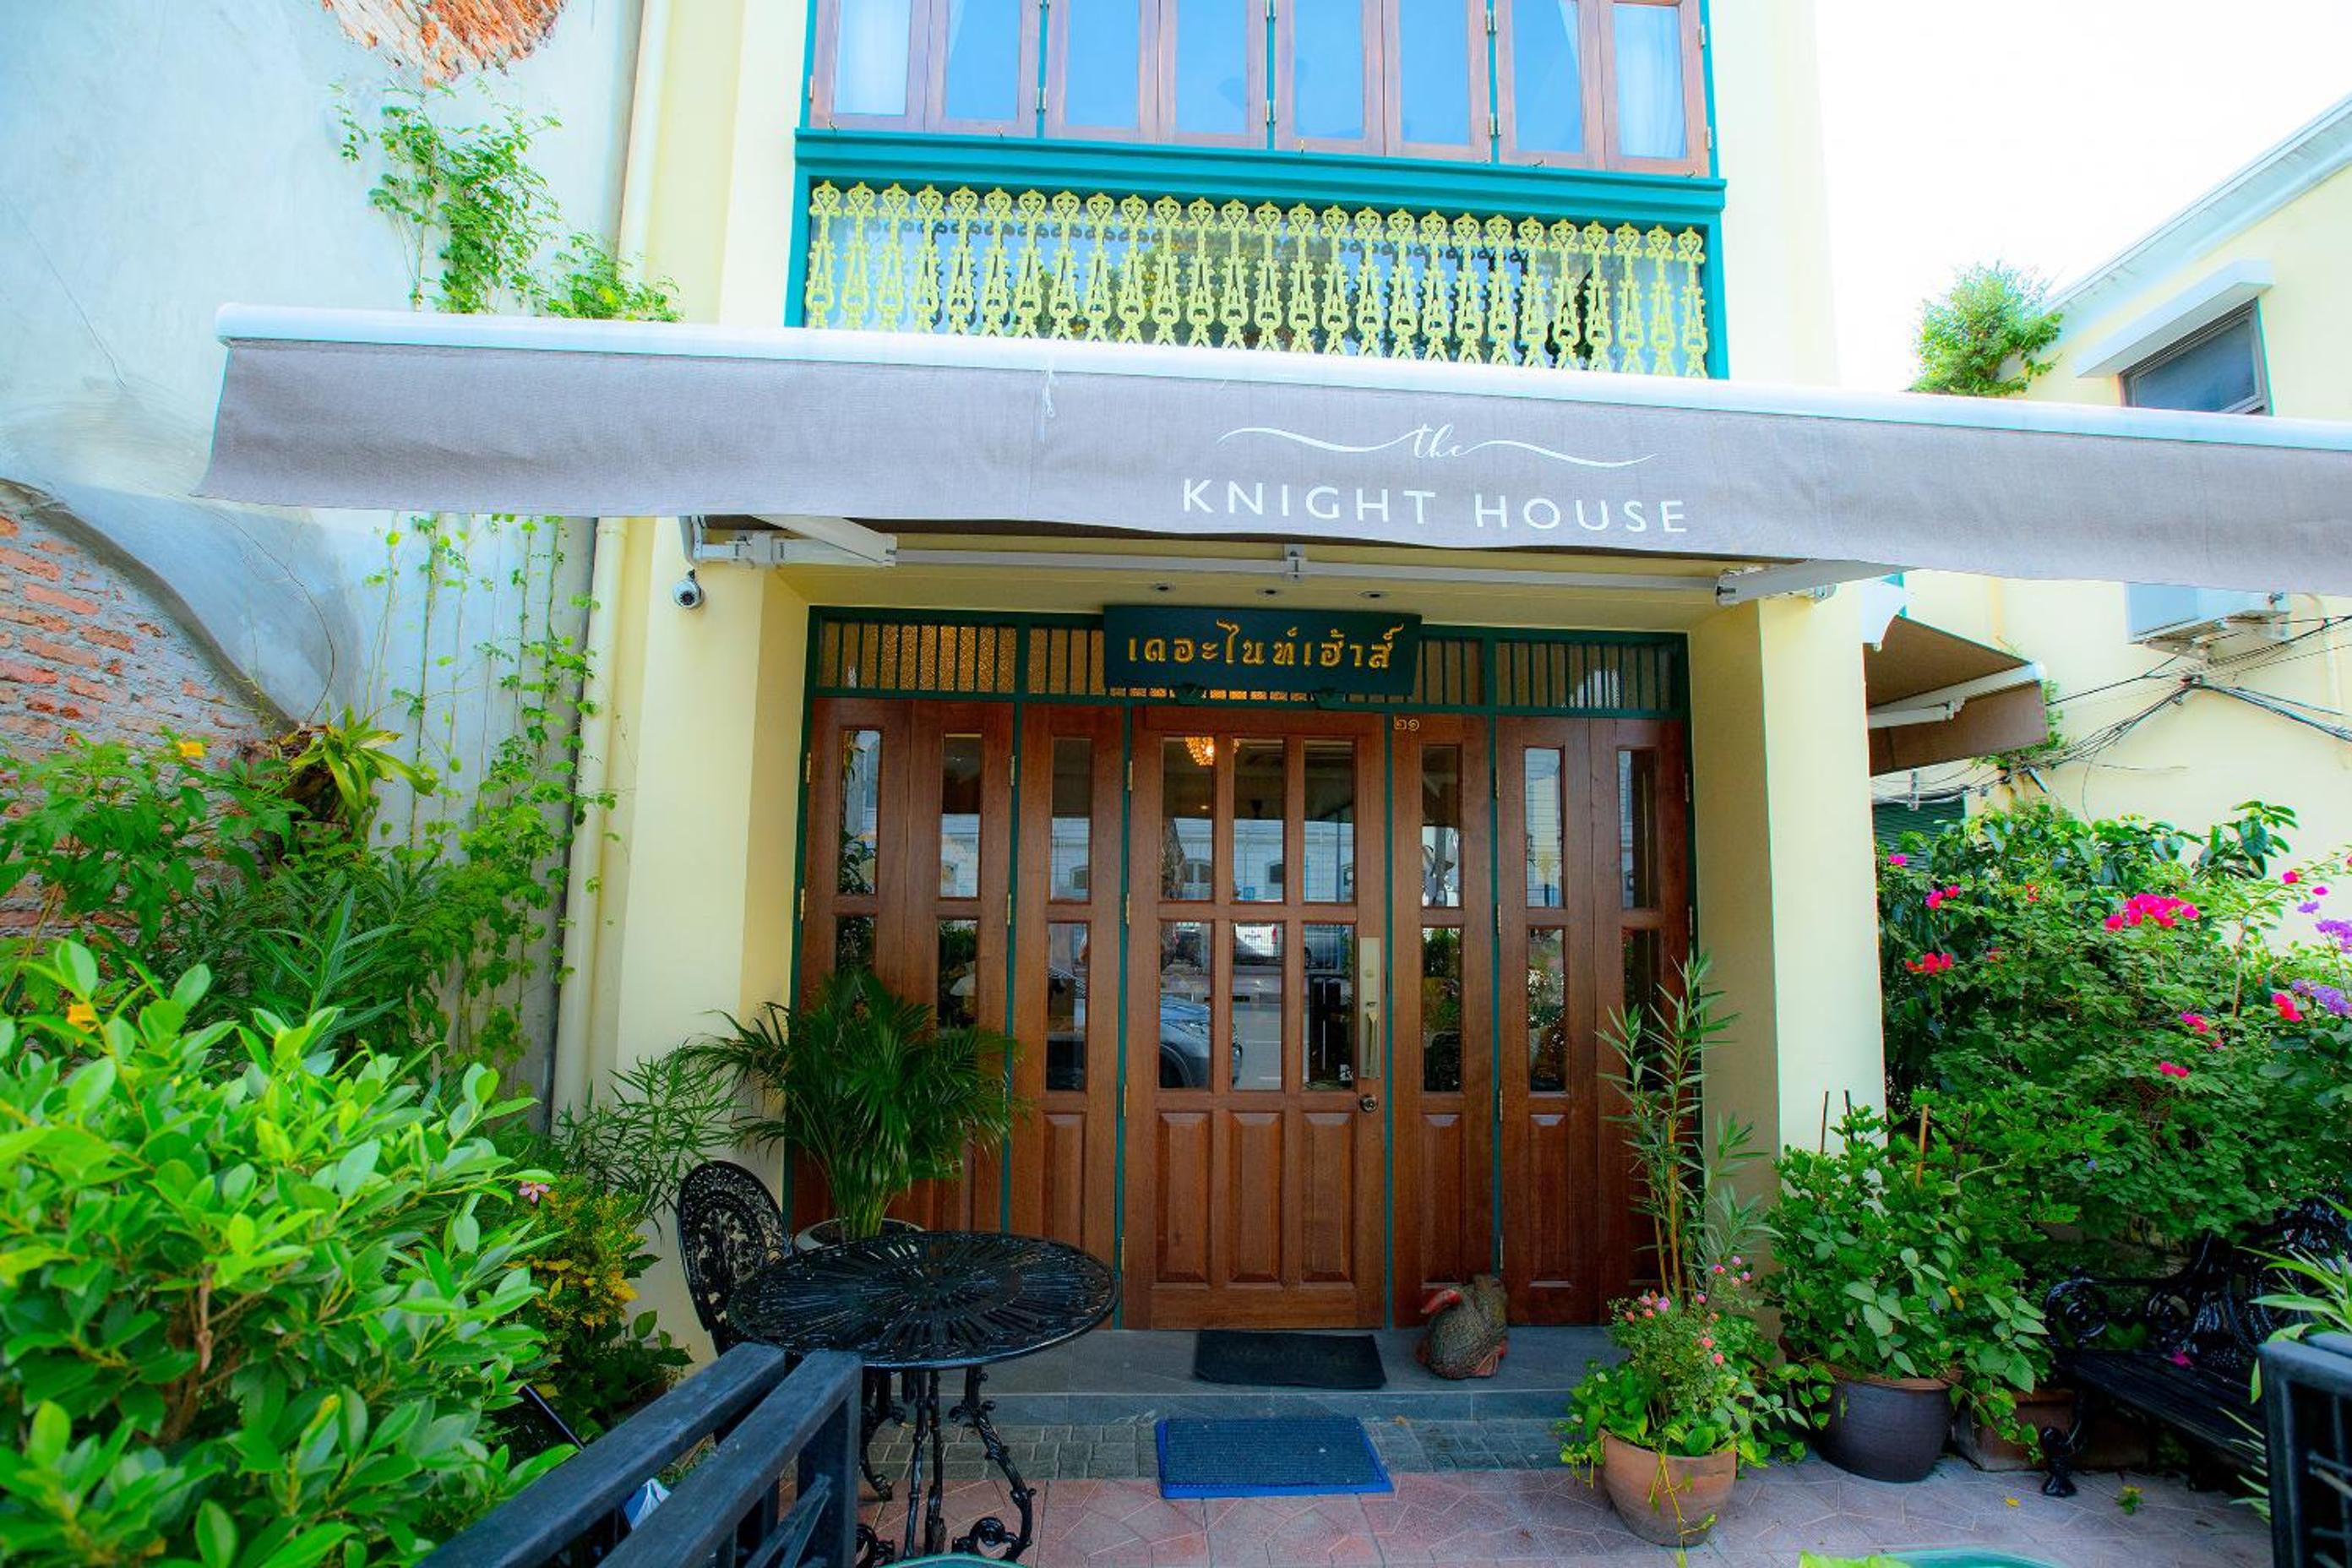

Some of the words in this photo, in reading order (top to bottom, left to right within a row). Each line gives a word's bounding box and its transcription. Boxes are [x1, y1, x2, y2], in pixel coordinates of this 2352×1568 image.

[1411, 423, 1463, 458] the
[1183, 478, 1436, 525] KNIGHT
[1474, 493, 1687, 533] HOUSE
[1128, 618, 1404, 670] เดอะไนท์เฮ้าส์
